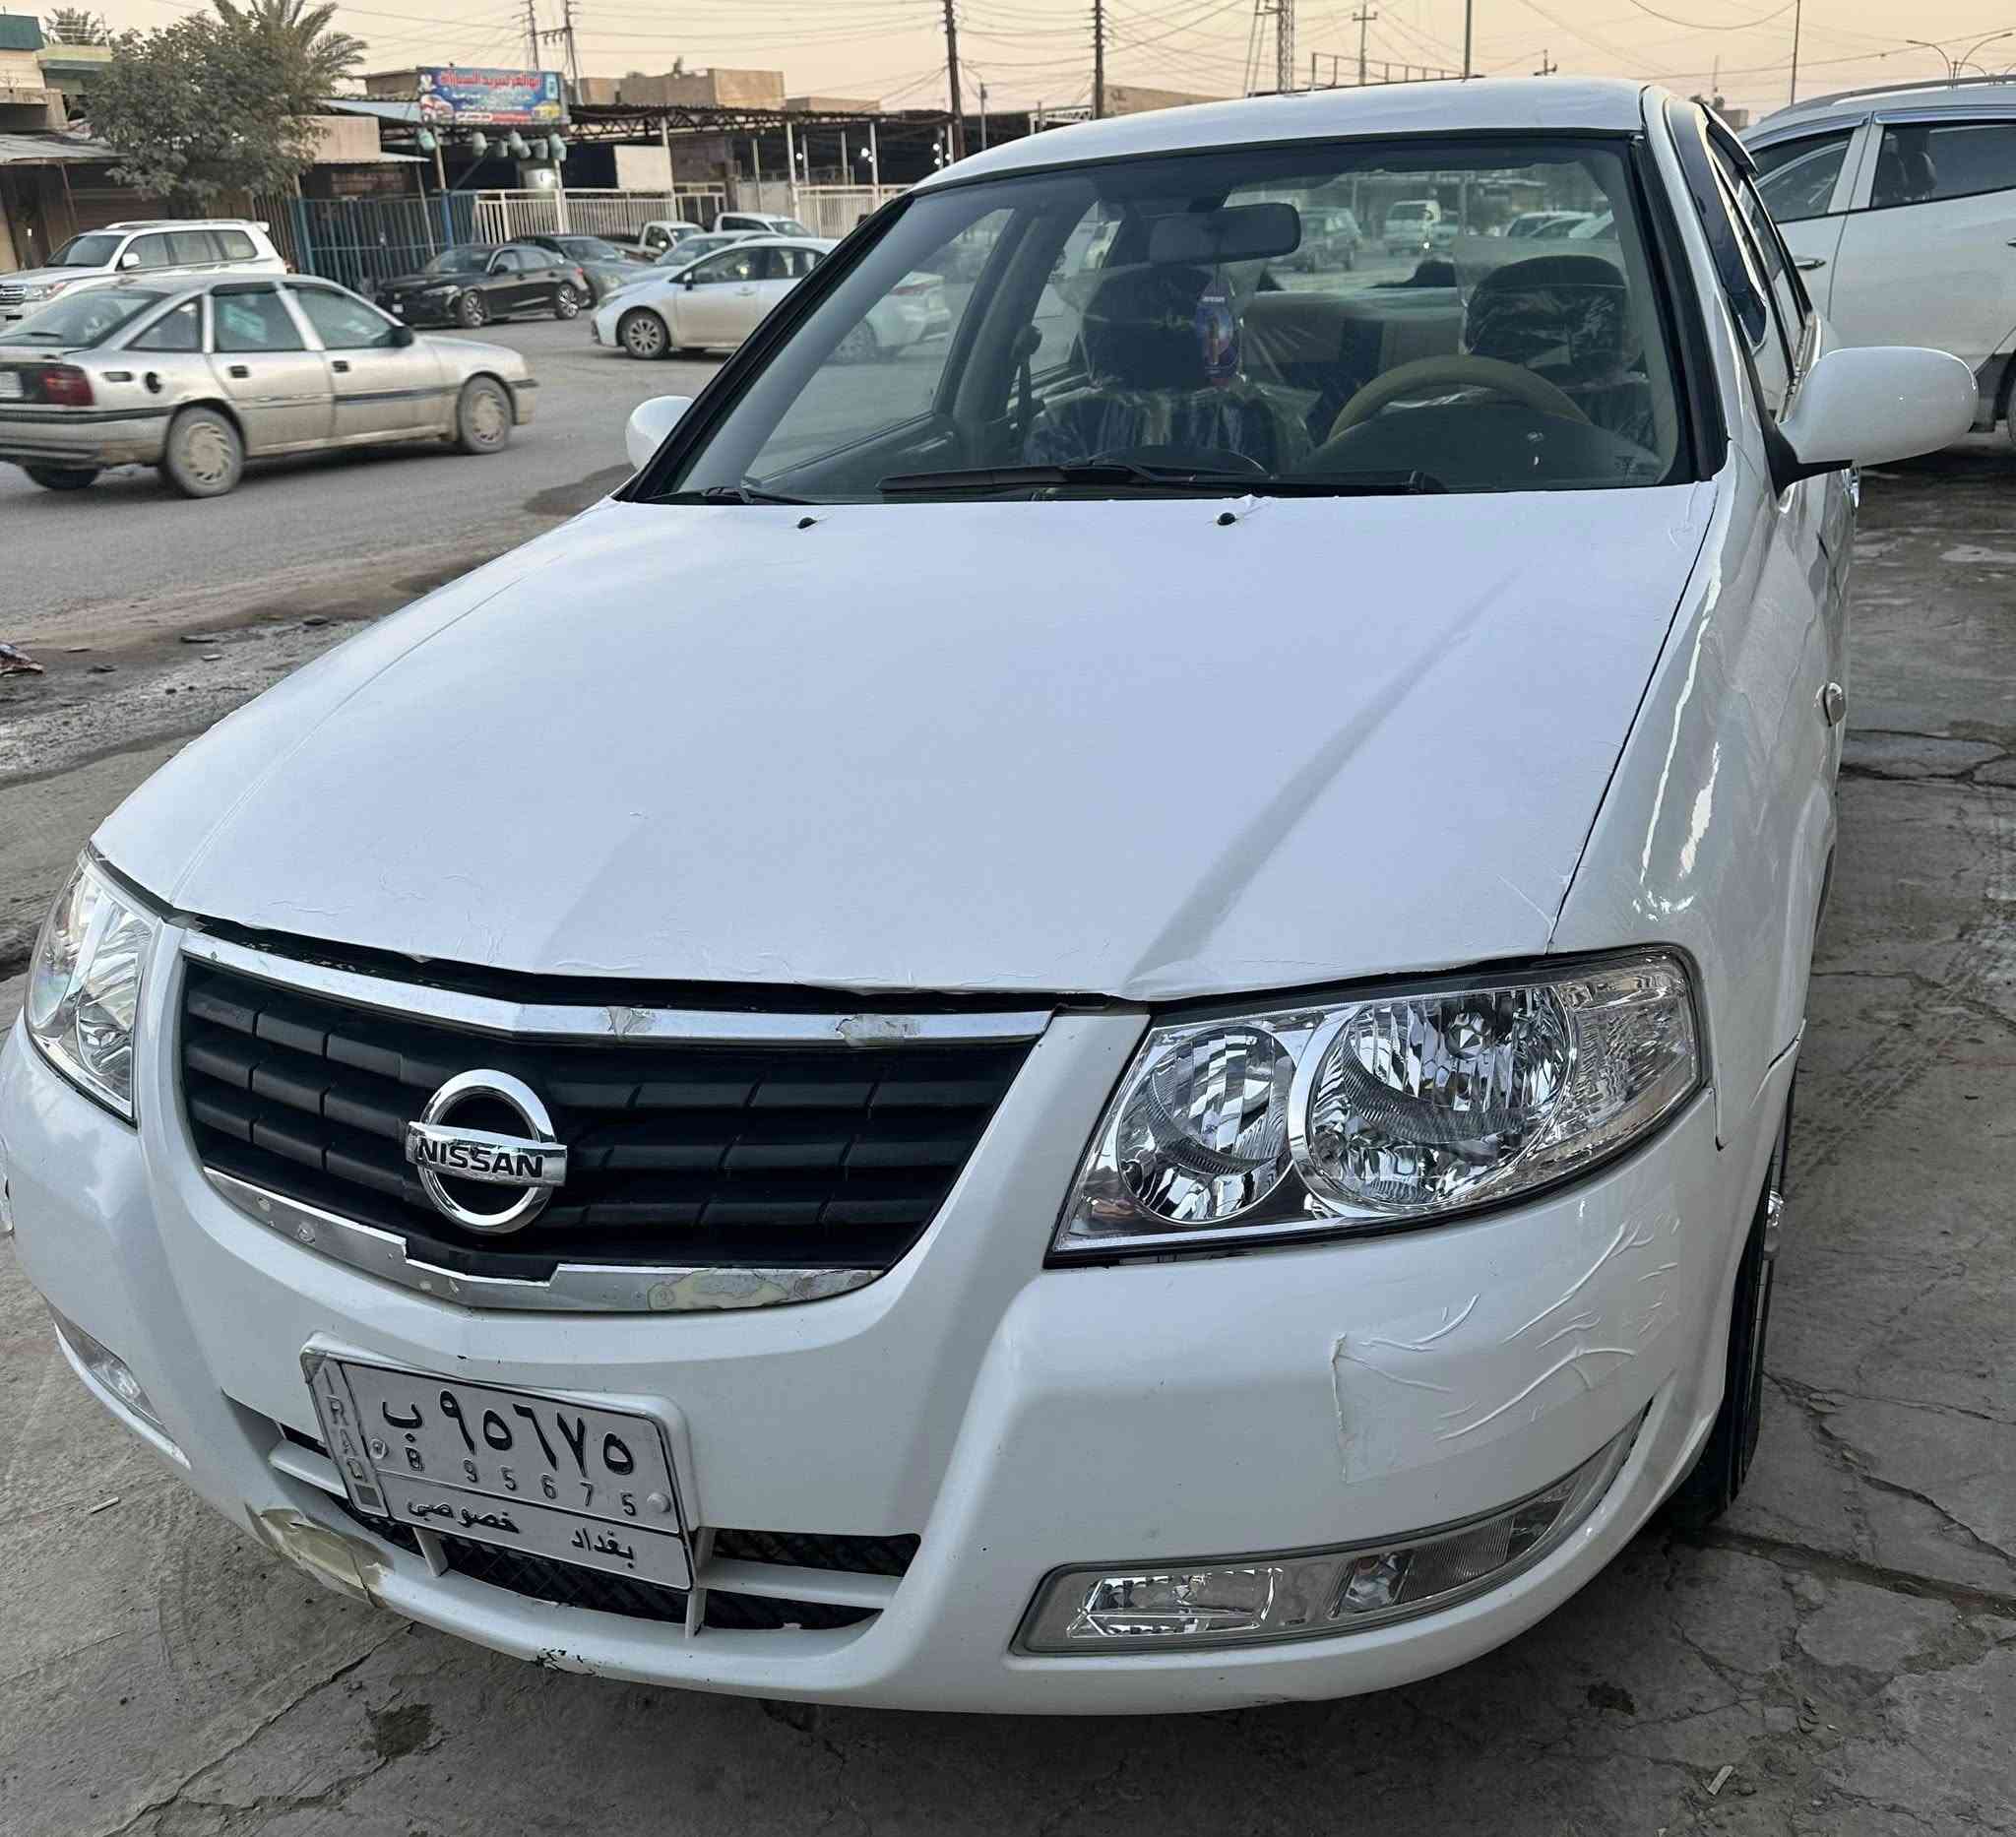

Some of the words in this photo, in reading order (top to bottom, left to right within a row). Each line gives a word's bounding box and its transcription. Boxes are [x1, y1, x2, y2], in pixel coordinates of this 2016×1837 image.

[415, 1136, 544, 1178] NISSAN
[382, 1401, 423, 1443] ب
[439, 1389, 635, 1476] ٩٥٦٧٥
[407, 1501, 520, 1535] خصوصي
[571, 1527, 634, 1569] بغداد
